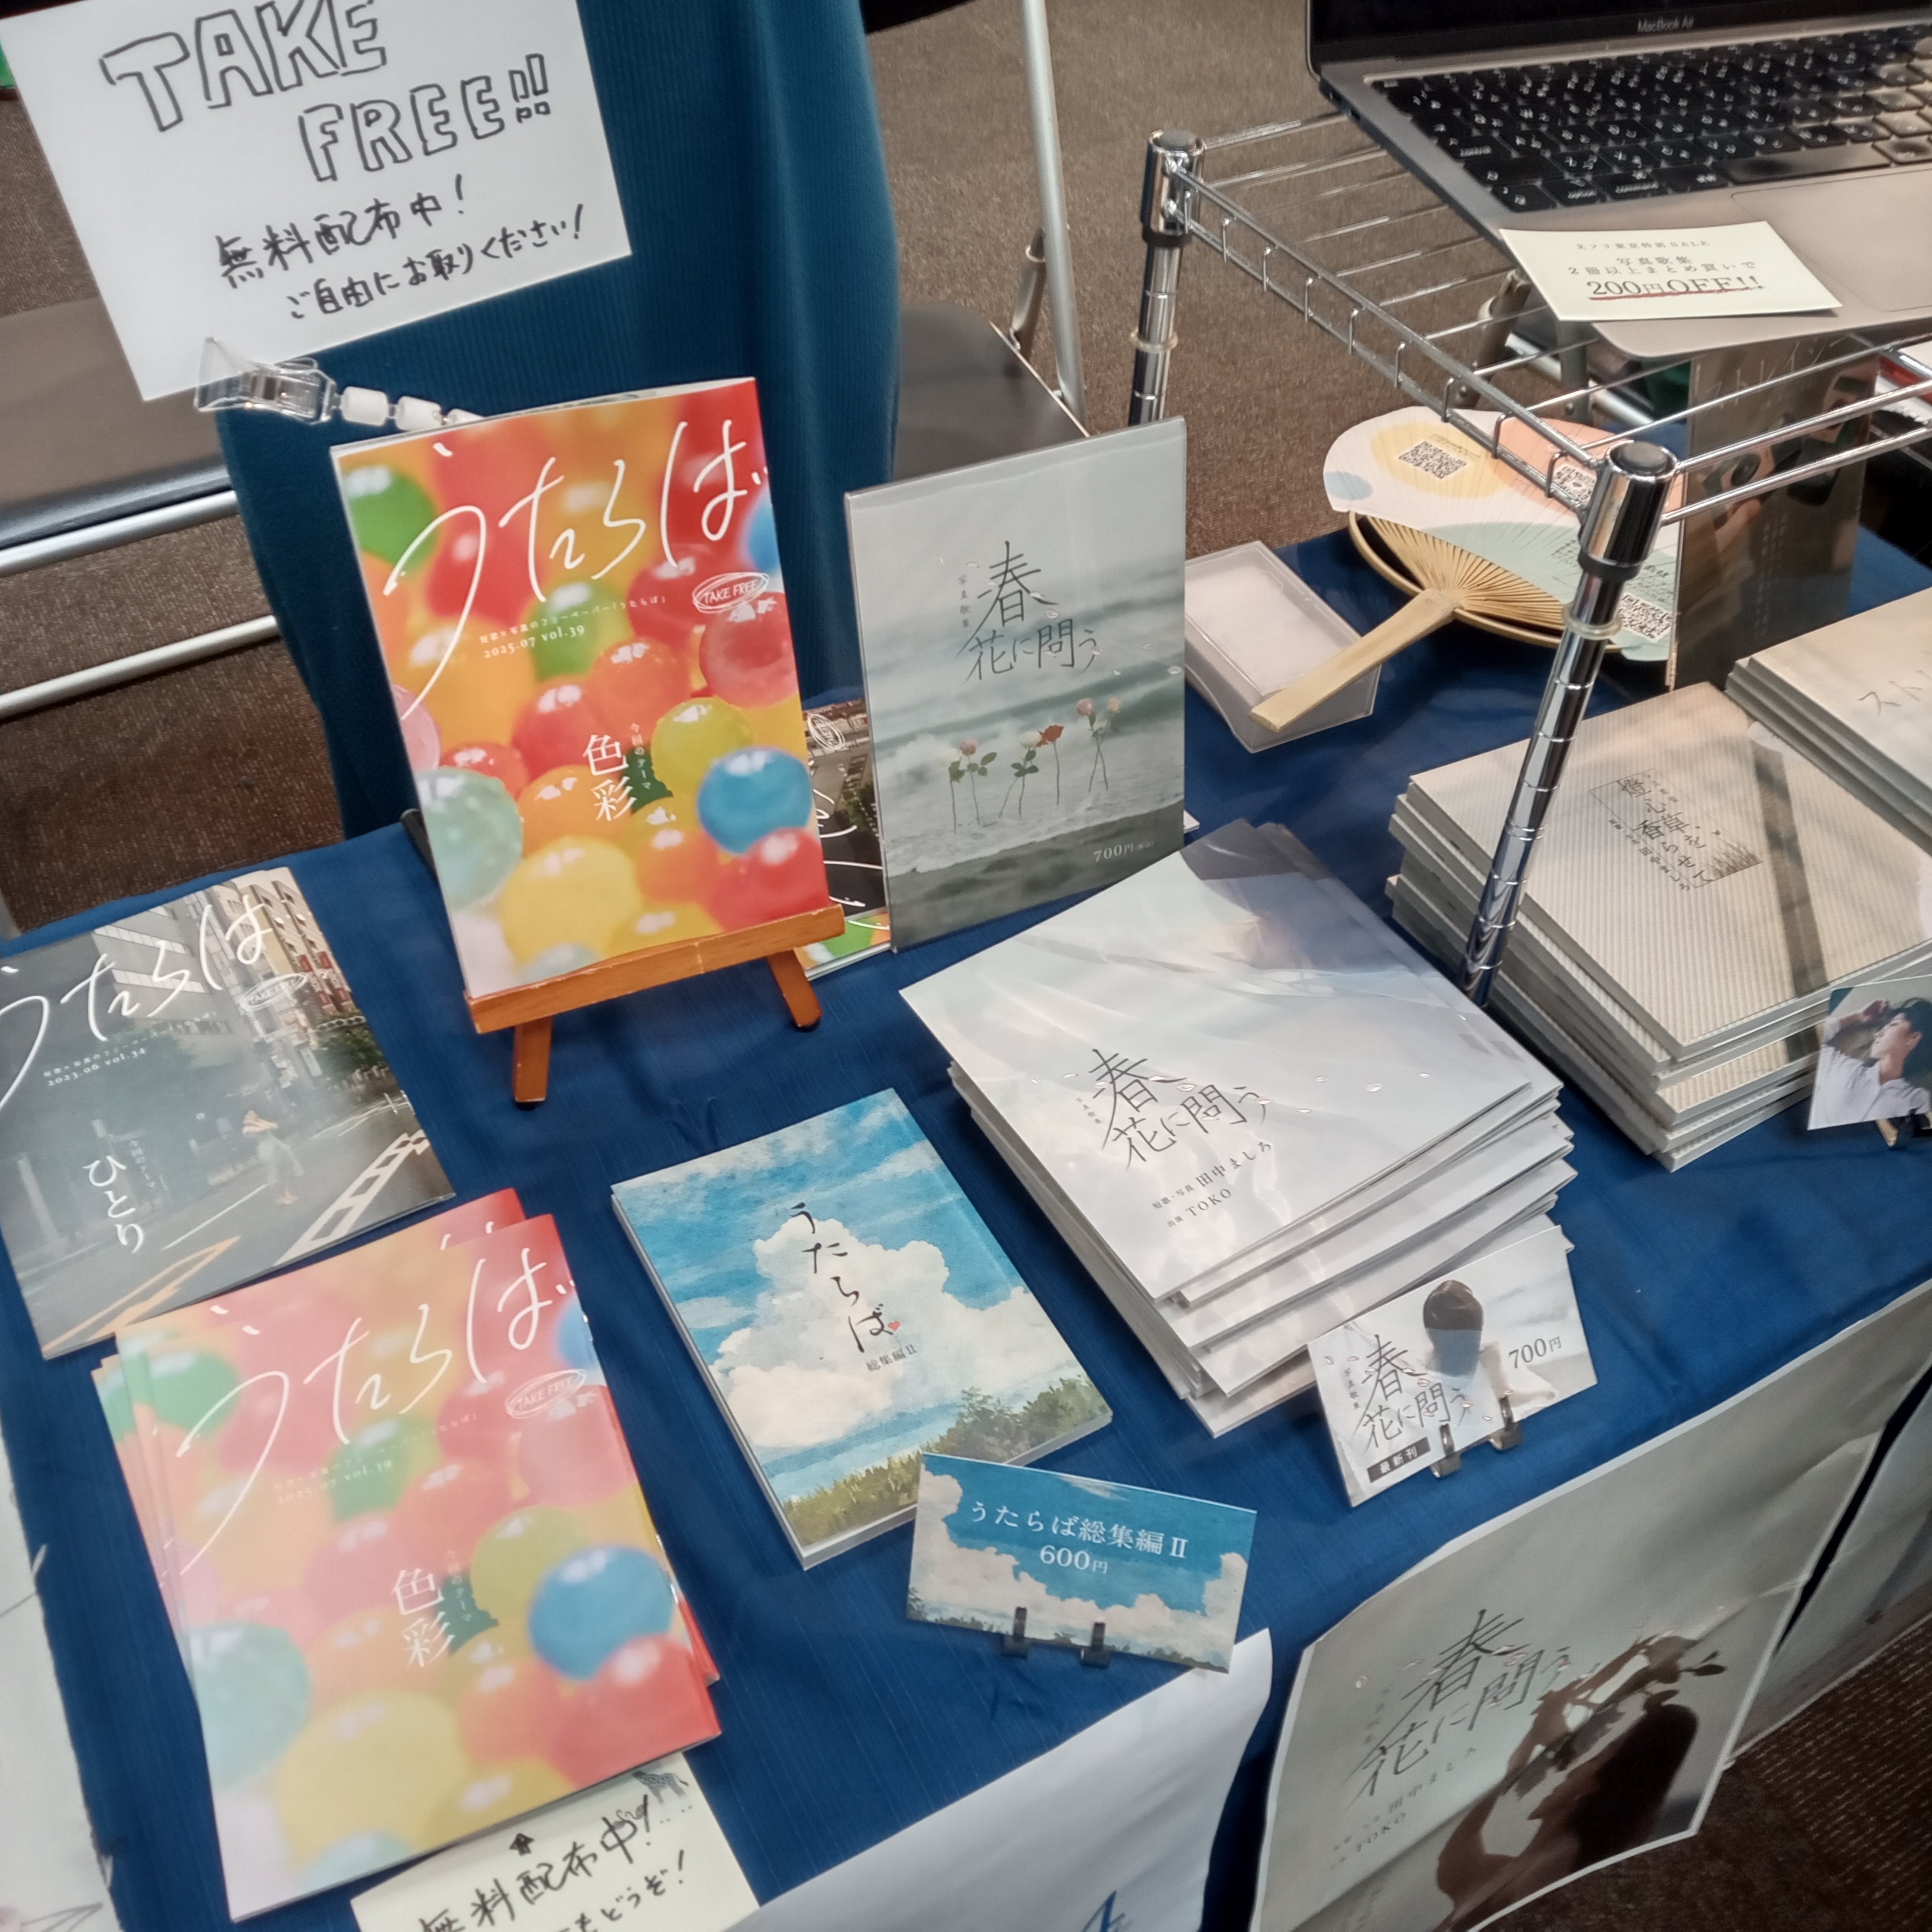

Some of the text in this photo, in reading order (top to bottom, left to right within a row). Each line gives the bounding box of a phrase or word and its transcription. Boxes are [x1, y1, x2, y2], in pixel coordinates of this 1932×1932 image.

[1638, 18, 1694, 33] MacBook Air
[100, 0, 387, 132] TAKE
[299, 53, 551, 181] FREE!!
[703, 580, 760, 605] TAKE FREE
[956, 540, 1059, 658] 春
[484, 625, 585, 659] 2025.07 vol.39
[582, 734, 637, 822] 色彩
[104, 1047, 147, 1066] vol.34
[1088, 1049, 1188, 1151] 春
[1195, 1141, 1271, 1187] 田中ましろ
[82, 1155, 144, 1254] ひとり
[1185, 1188, 1232, 1217] TOKO
[790, 1201, 894, 1353] うたらば
[1508, 1336, 1562, 1369] 700円
[1380, 1445, 1418, 1474] 最新刊
[970, 1501, 1189, 1559] うたらば総集編Ⅱ
[1040, 1544, 1108, 1575] 600円
[389, 1568, 455, 1668] 色彩
